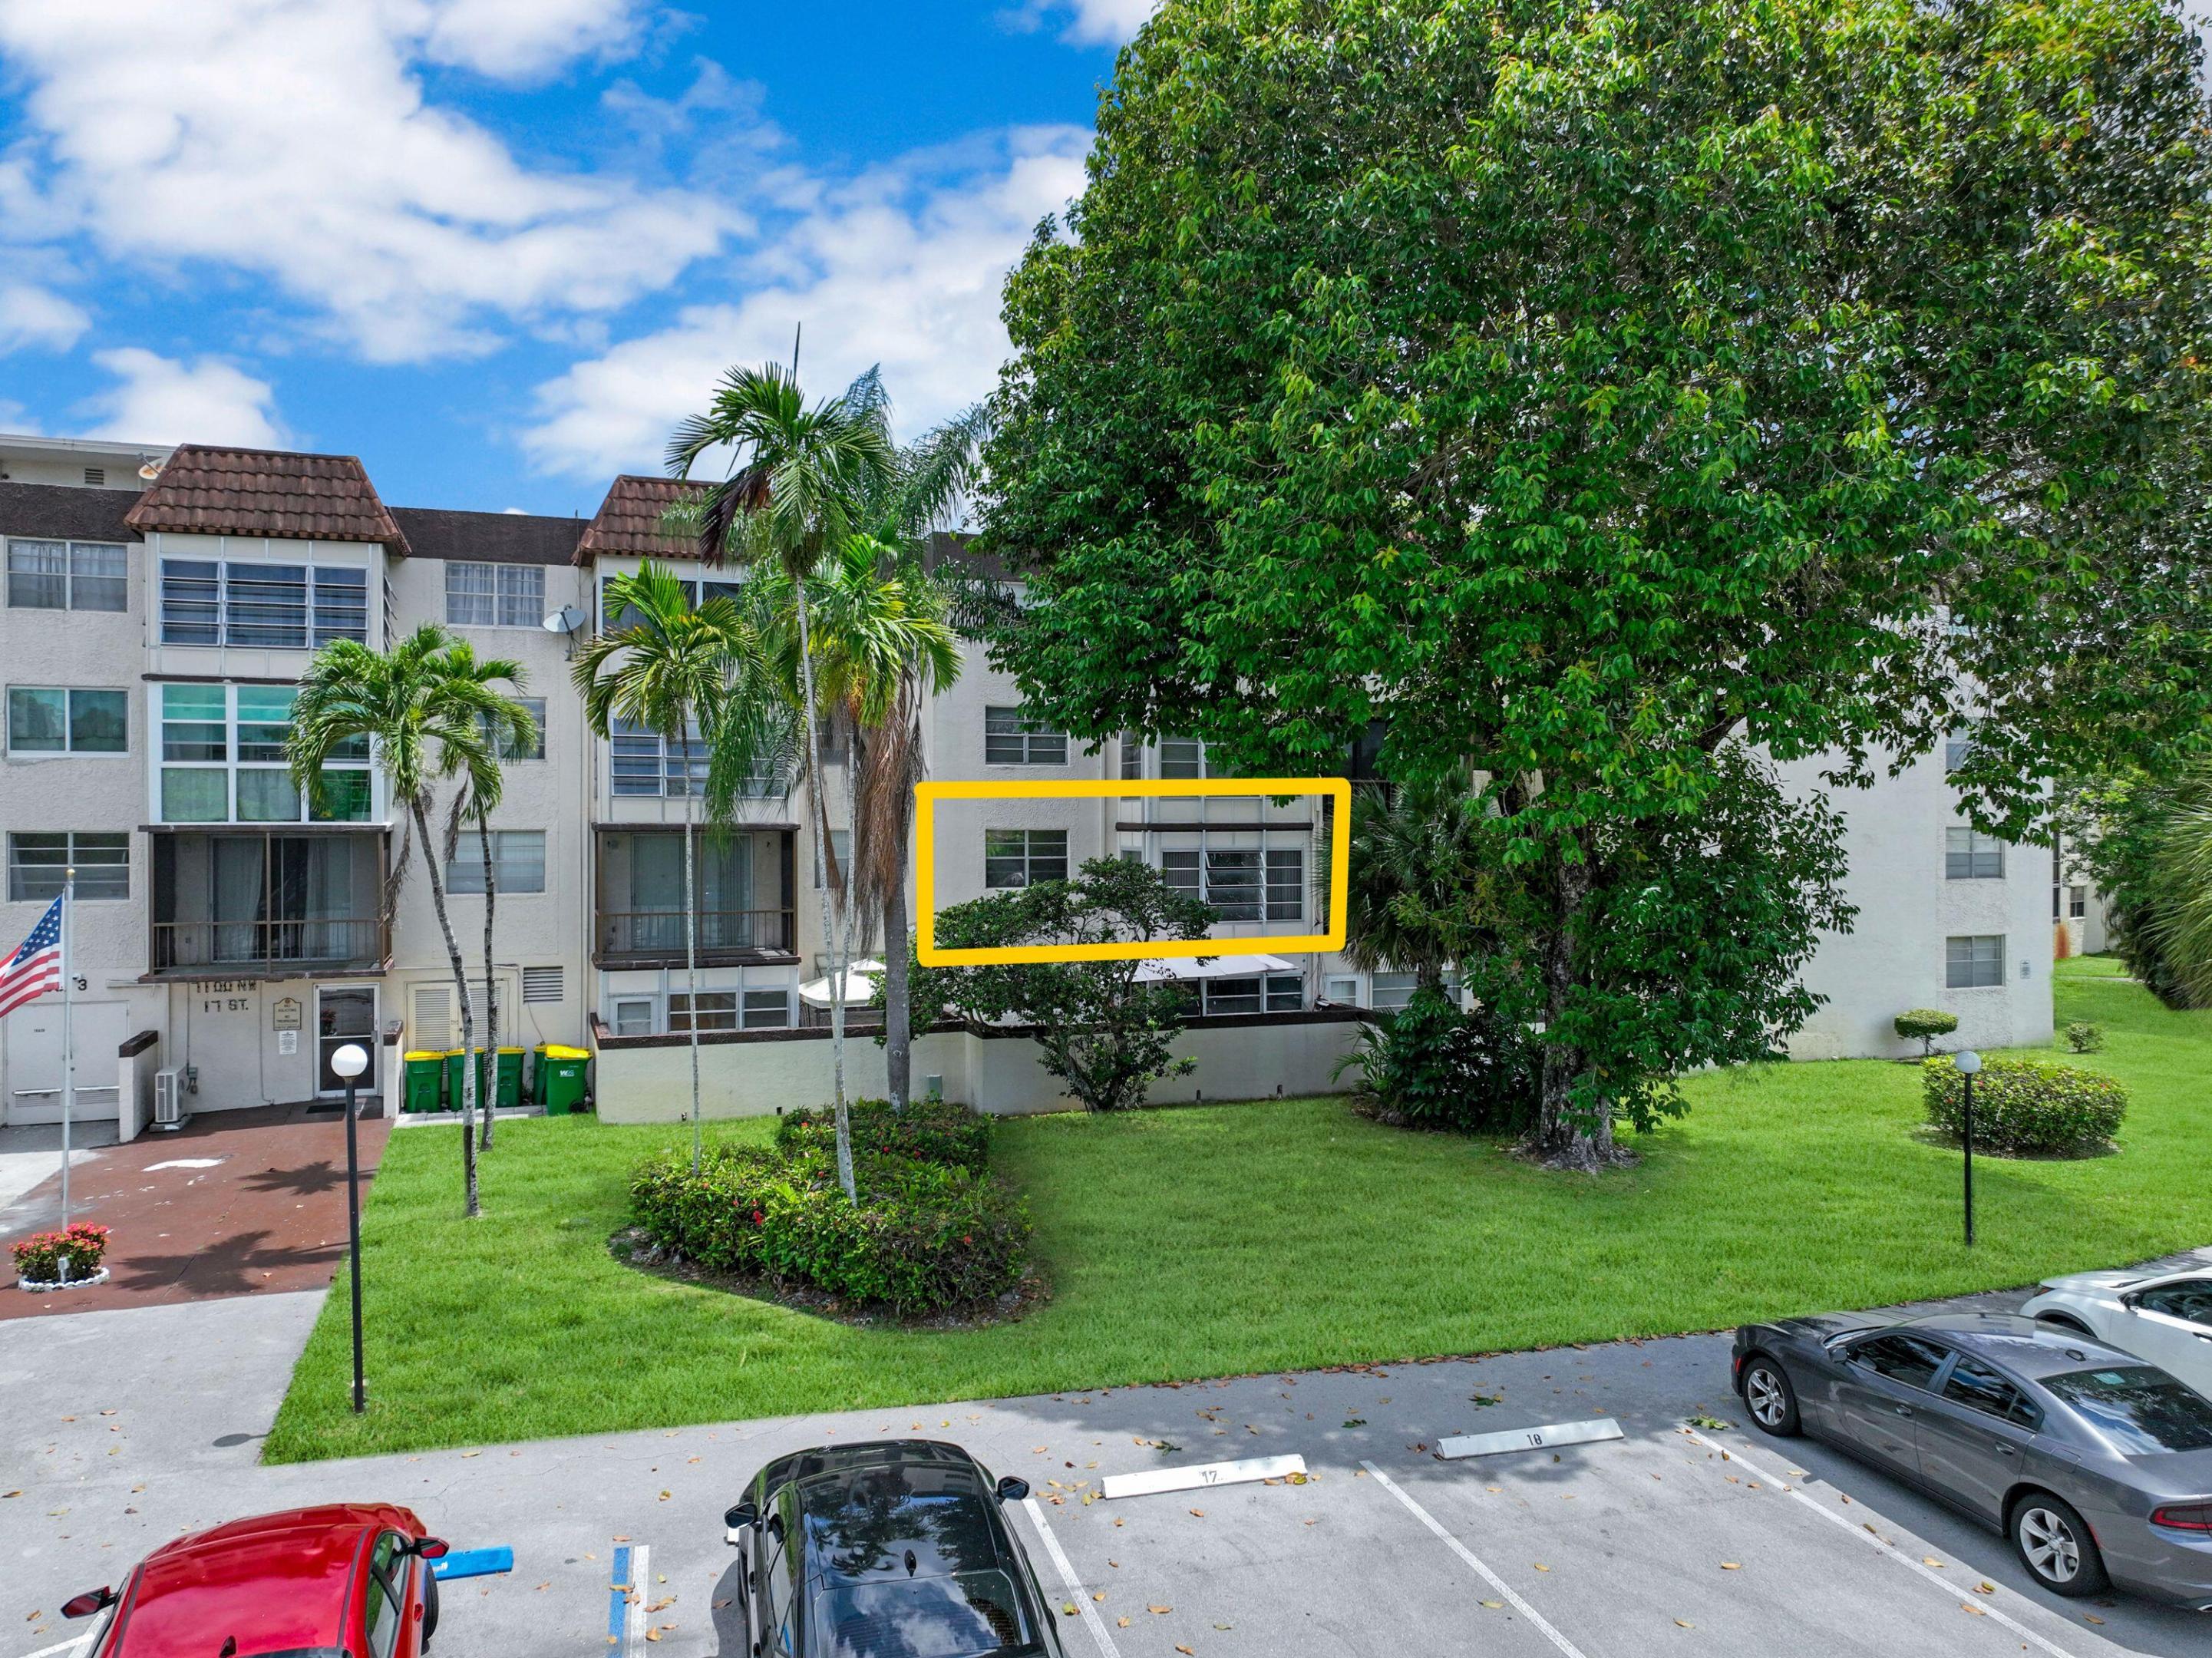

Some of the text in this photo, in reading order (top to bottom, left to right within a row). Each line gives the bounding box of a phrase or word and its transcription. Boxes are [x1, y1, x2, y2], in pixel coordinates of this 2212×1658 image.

[78, 979, 87, 991] 3
[196, 981, 233, 993] 1100
[205, 999, 249, 1012] 17 ST.
[1527, 1433, 1543, 1445] 18
[1201, 1470, 1217, 1483] 17
